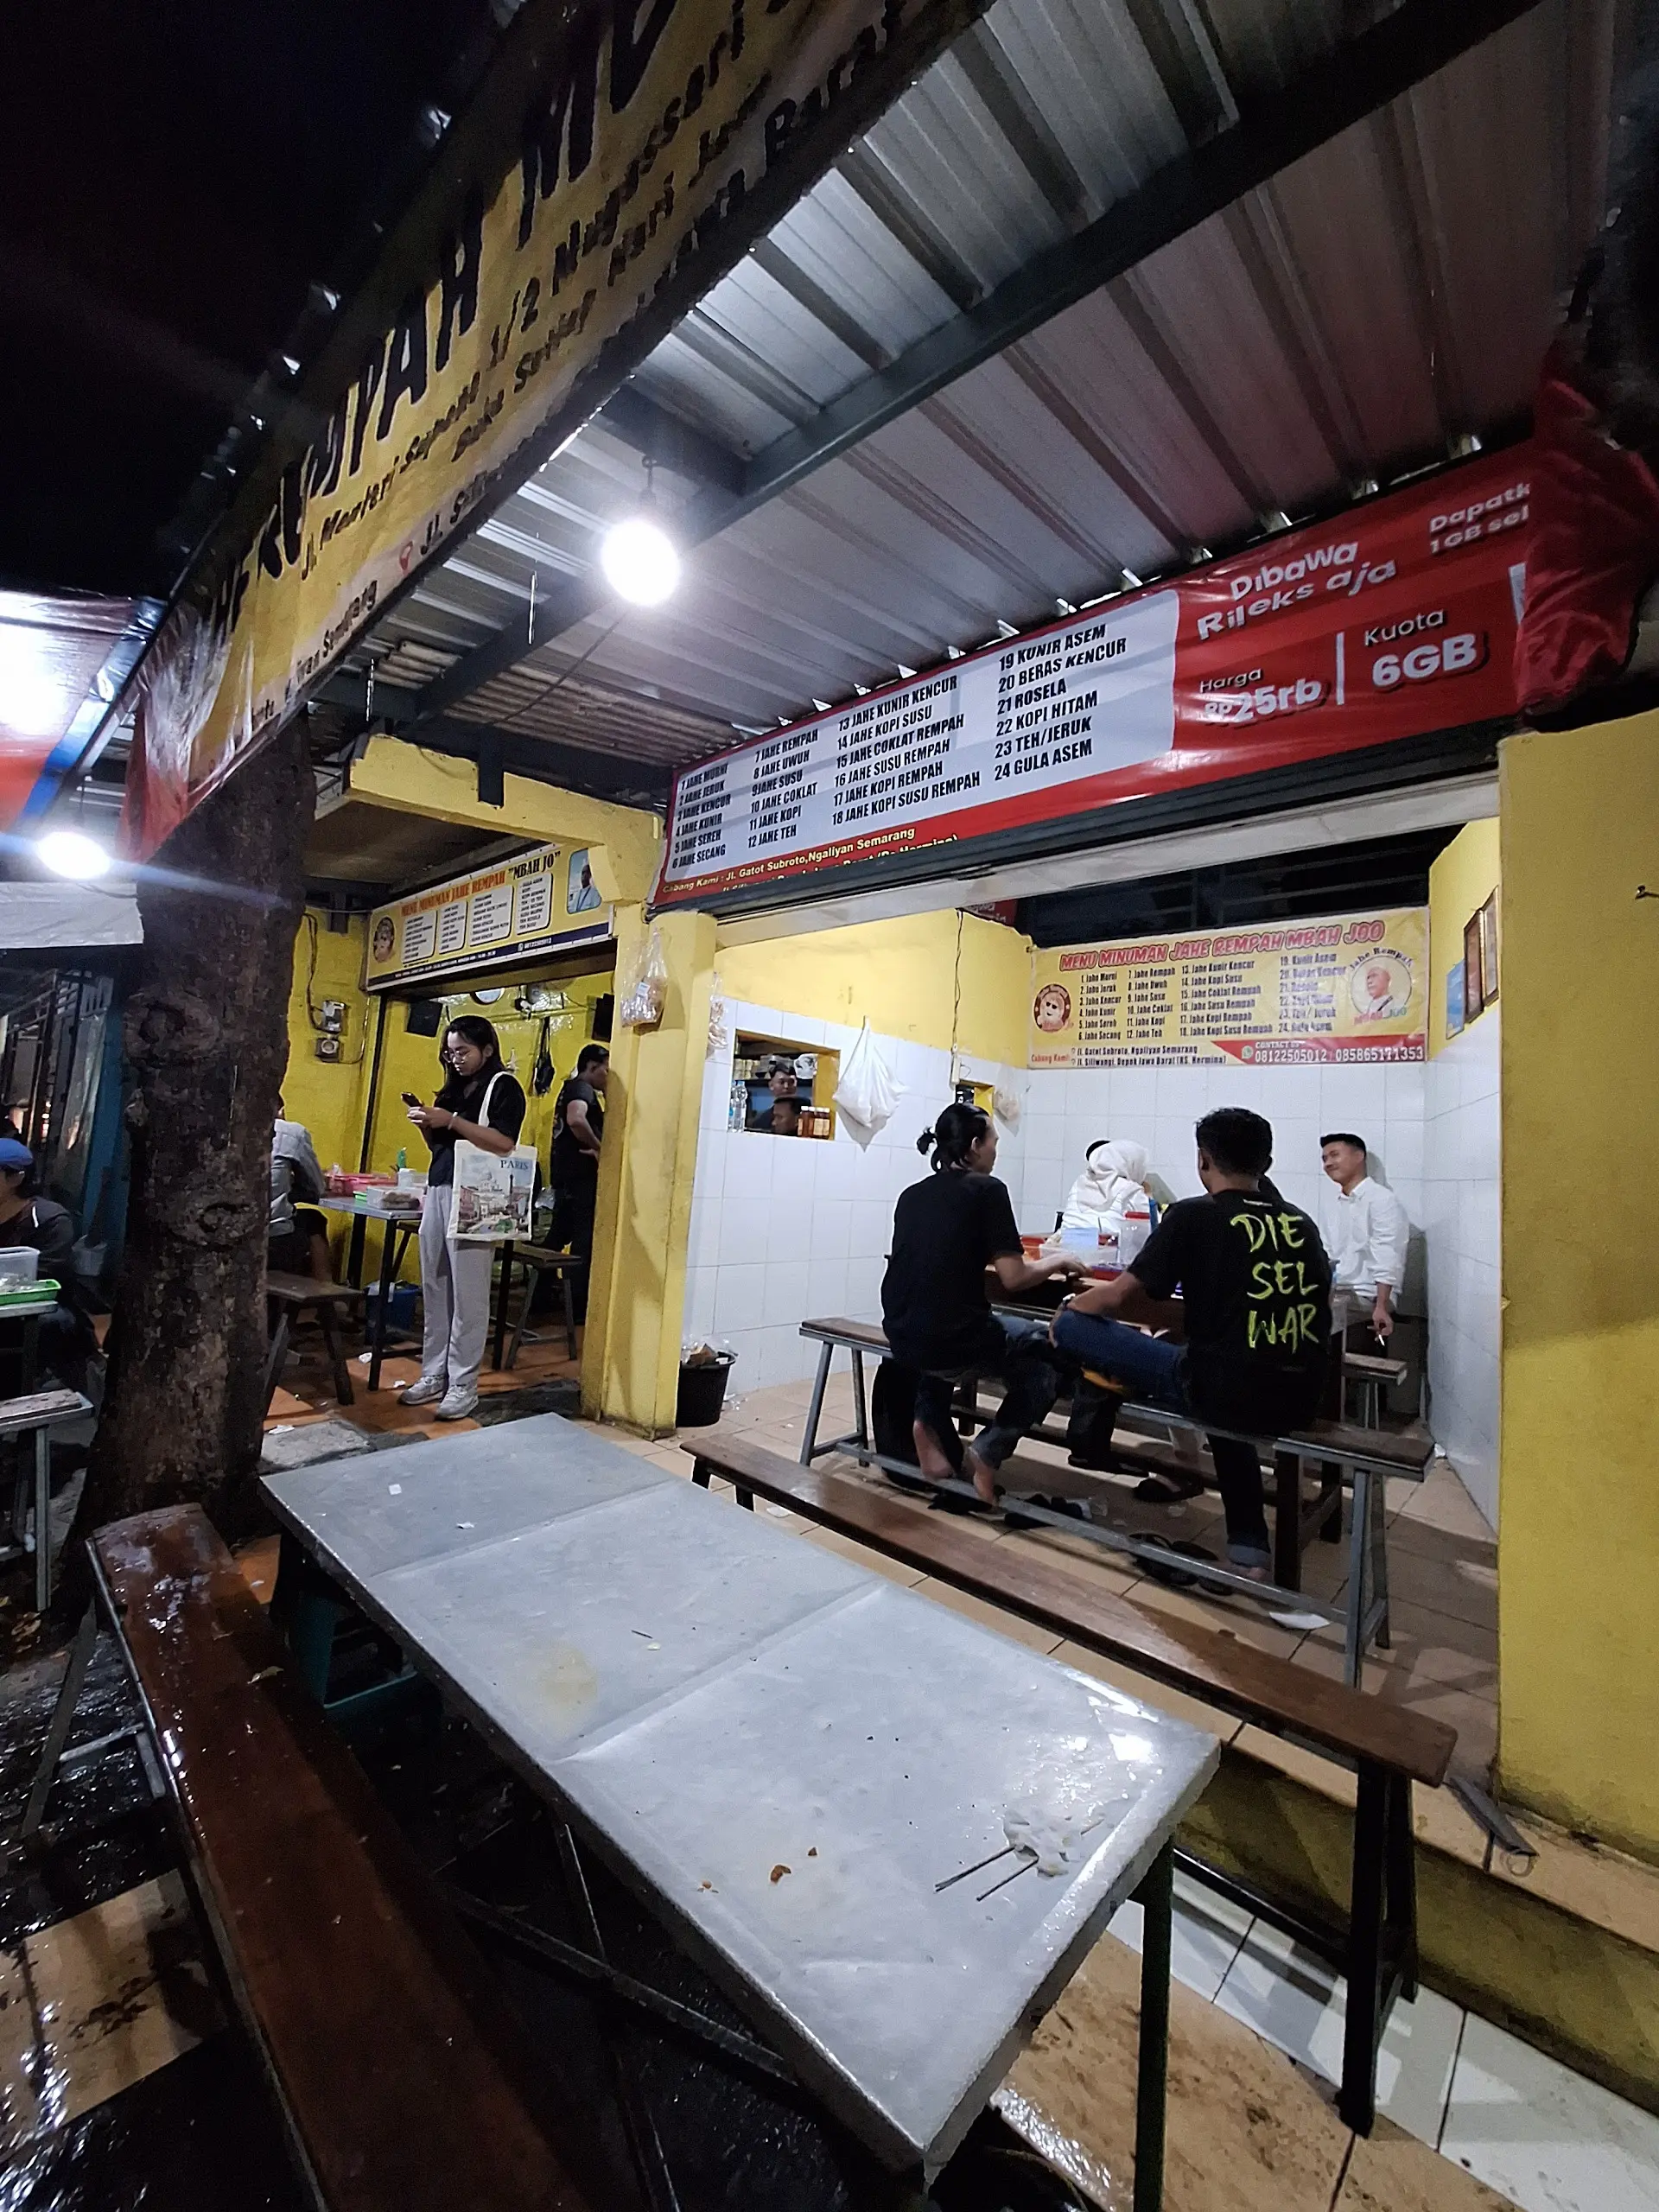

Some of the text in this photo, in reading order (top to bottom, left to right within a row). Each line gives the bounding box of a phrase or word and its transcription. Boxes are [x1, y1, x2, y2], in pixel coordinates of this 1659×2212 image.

[1230, 542, 1358, 601] Dibawa
[1198, 560, 1396, 640] Rileks aja
[1000, 624, 1106, 671] 19 KUNIR ASEM
[1364, 609, 1444, 646] Kuota
[998, 639, 1127, 693] 20 BERAS KENCUR
[1373, 633, 1477, 687] 6GB
[998, 678, 1067, 715] 21 ROSELA
[1199, 668, 1262, 694] Harga
[839, 675, 957, 731] 13 JAHE KUNIR KENCUR
[996, 690, 1097, 736] 22 KOPI HITAM
[755, 729, 818, 763] 7 JAHE REMPAH
[836, 714, 964, 769] 15 JAHE COKLAT REMPAH
[838, 705, 932, 750] 14 JAHE KOPI SUSU
[995, 716, 1091, 759] 23 TEH/JERUK
[753, 750, 810, 779] 8 JAHE UWUH
[779, 770, 803, 786] SUSU
[836, 739, 950, 787] 16 JAHE SUSU REMPAH
[995, 739, 1092, 780] 24 GULA ASEM
[680, 780, 725, 806] 2 JAHE JERUK
[682, 781, 685, 790] 1
[687, 773, 702, 789] JAHE
[751, 782, 817, 813] 10 JAHE COKLAT
[832, 772, 980, 825] 18 JAHE KOPI SUSU REMPAH
[834, 761, 943, 806] 17 JAHE KOPI REMPAH
[677, 794, 731, 821] 3 JAHE KENCUR
[677, 813, 722, 836] 4 JAHE KUNIR
[750, 805, 801, 830] 11 JAHE KOPI
[672, 844, 726, 868] 6 JAHE SECANG
[675, 830, 721, 854] 5 JAHE SEREH
[748, 824, 797, 848] 12 JAHE TEH
[696, 876, 719, 887] Kami
[726, 870, 736, 881] Jl.
[739, 866, 765, 878] Gatot
[856, 827, 915, 852] Semarang
[1060, 920, 1385, 971] MENU MINUMAN JAHE REMPAH MBAH JOO
[1135, 970, 1148, 979] Jahe
[1255, 1046, 1423, 1063] 08122505012 085865171353
[500, 1160, 529, 1170] PARIS
[1230, 1211, 1305, 1253] DIE
[1246, 1260, 1319, 1300] SEL
[1248, 1303, 1319, 1354] WAR
